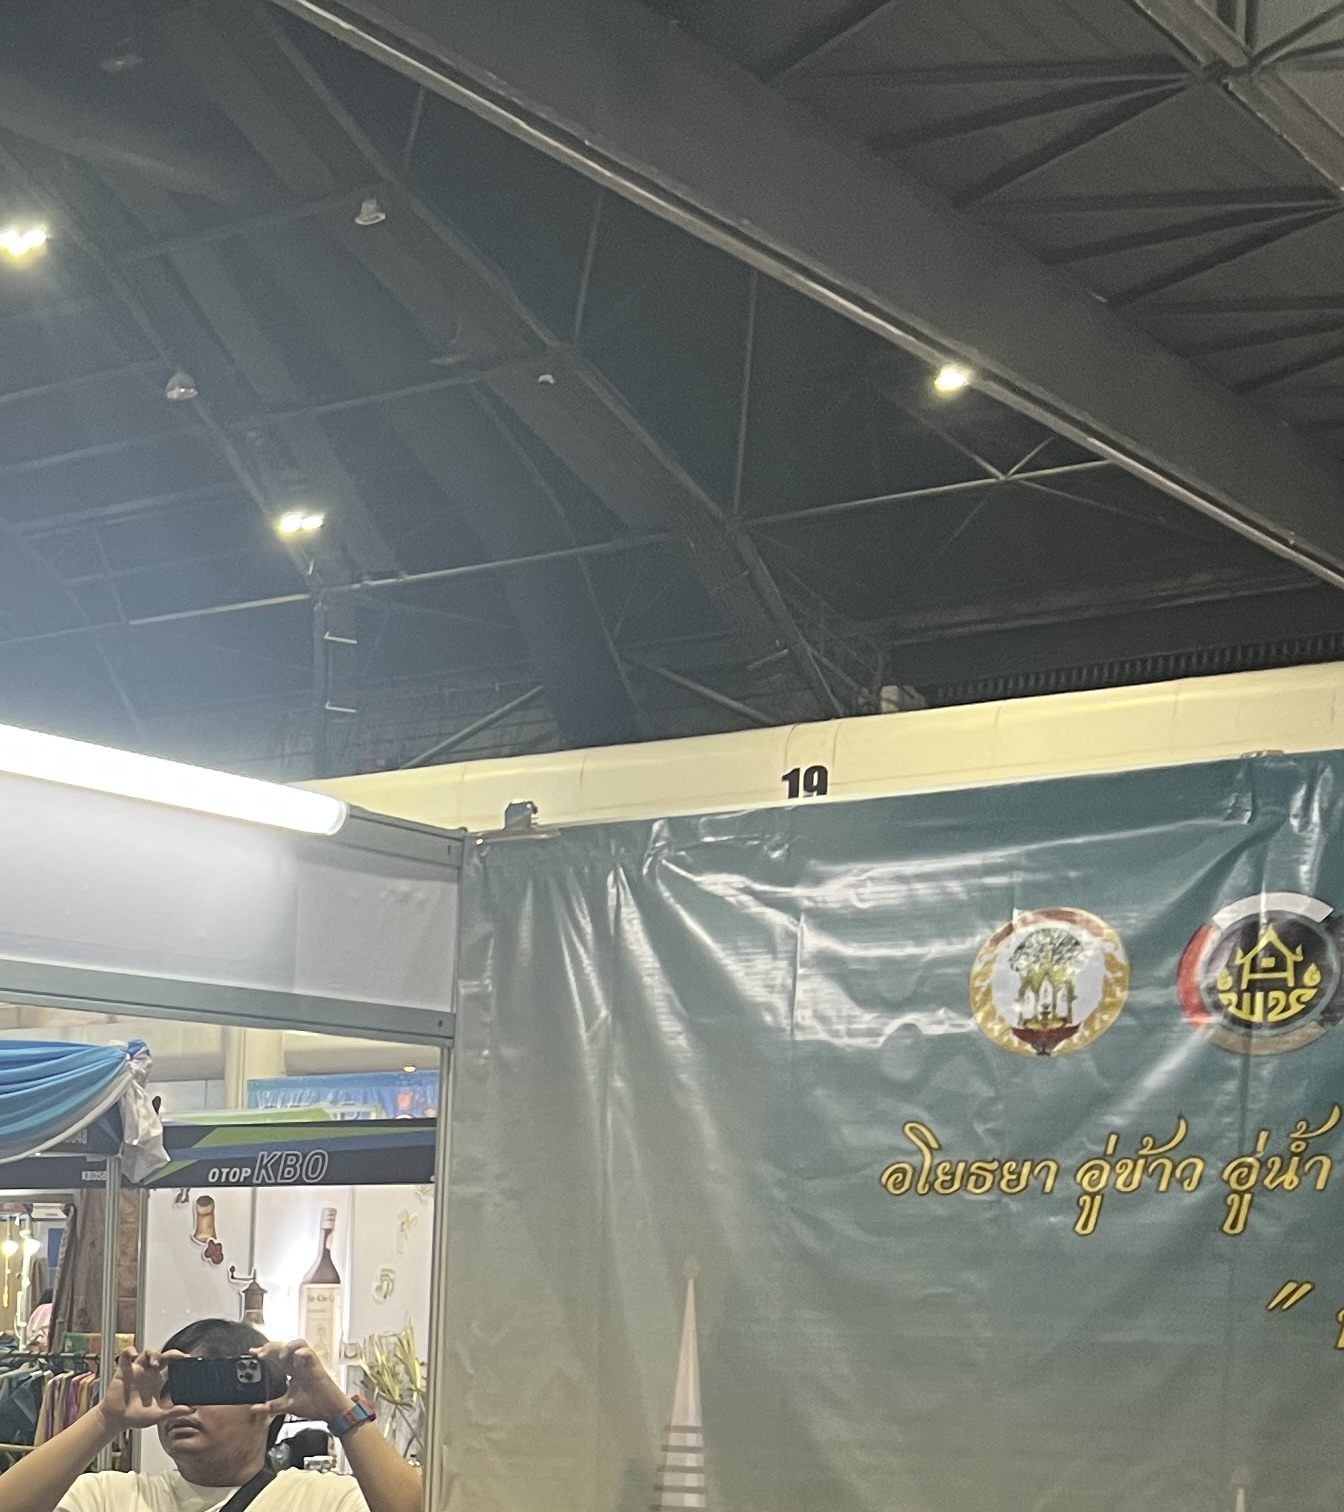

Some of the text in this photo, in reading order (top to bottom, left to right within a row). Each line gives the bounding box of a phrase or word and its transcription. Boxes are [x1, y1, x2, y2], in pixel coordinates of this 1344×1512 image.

[208, 1149, 329, 1184] OTOP KBO
[880, 1120, 1059, 1196] อโยธยา
[1073, 1114, 1206, 1236] อู่ข้าว
